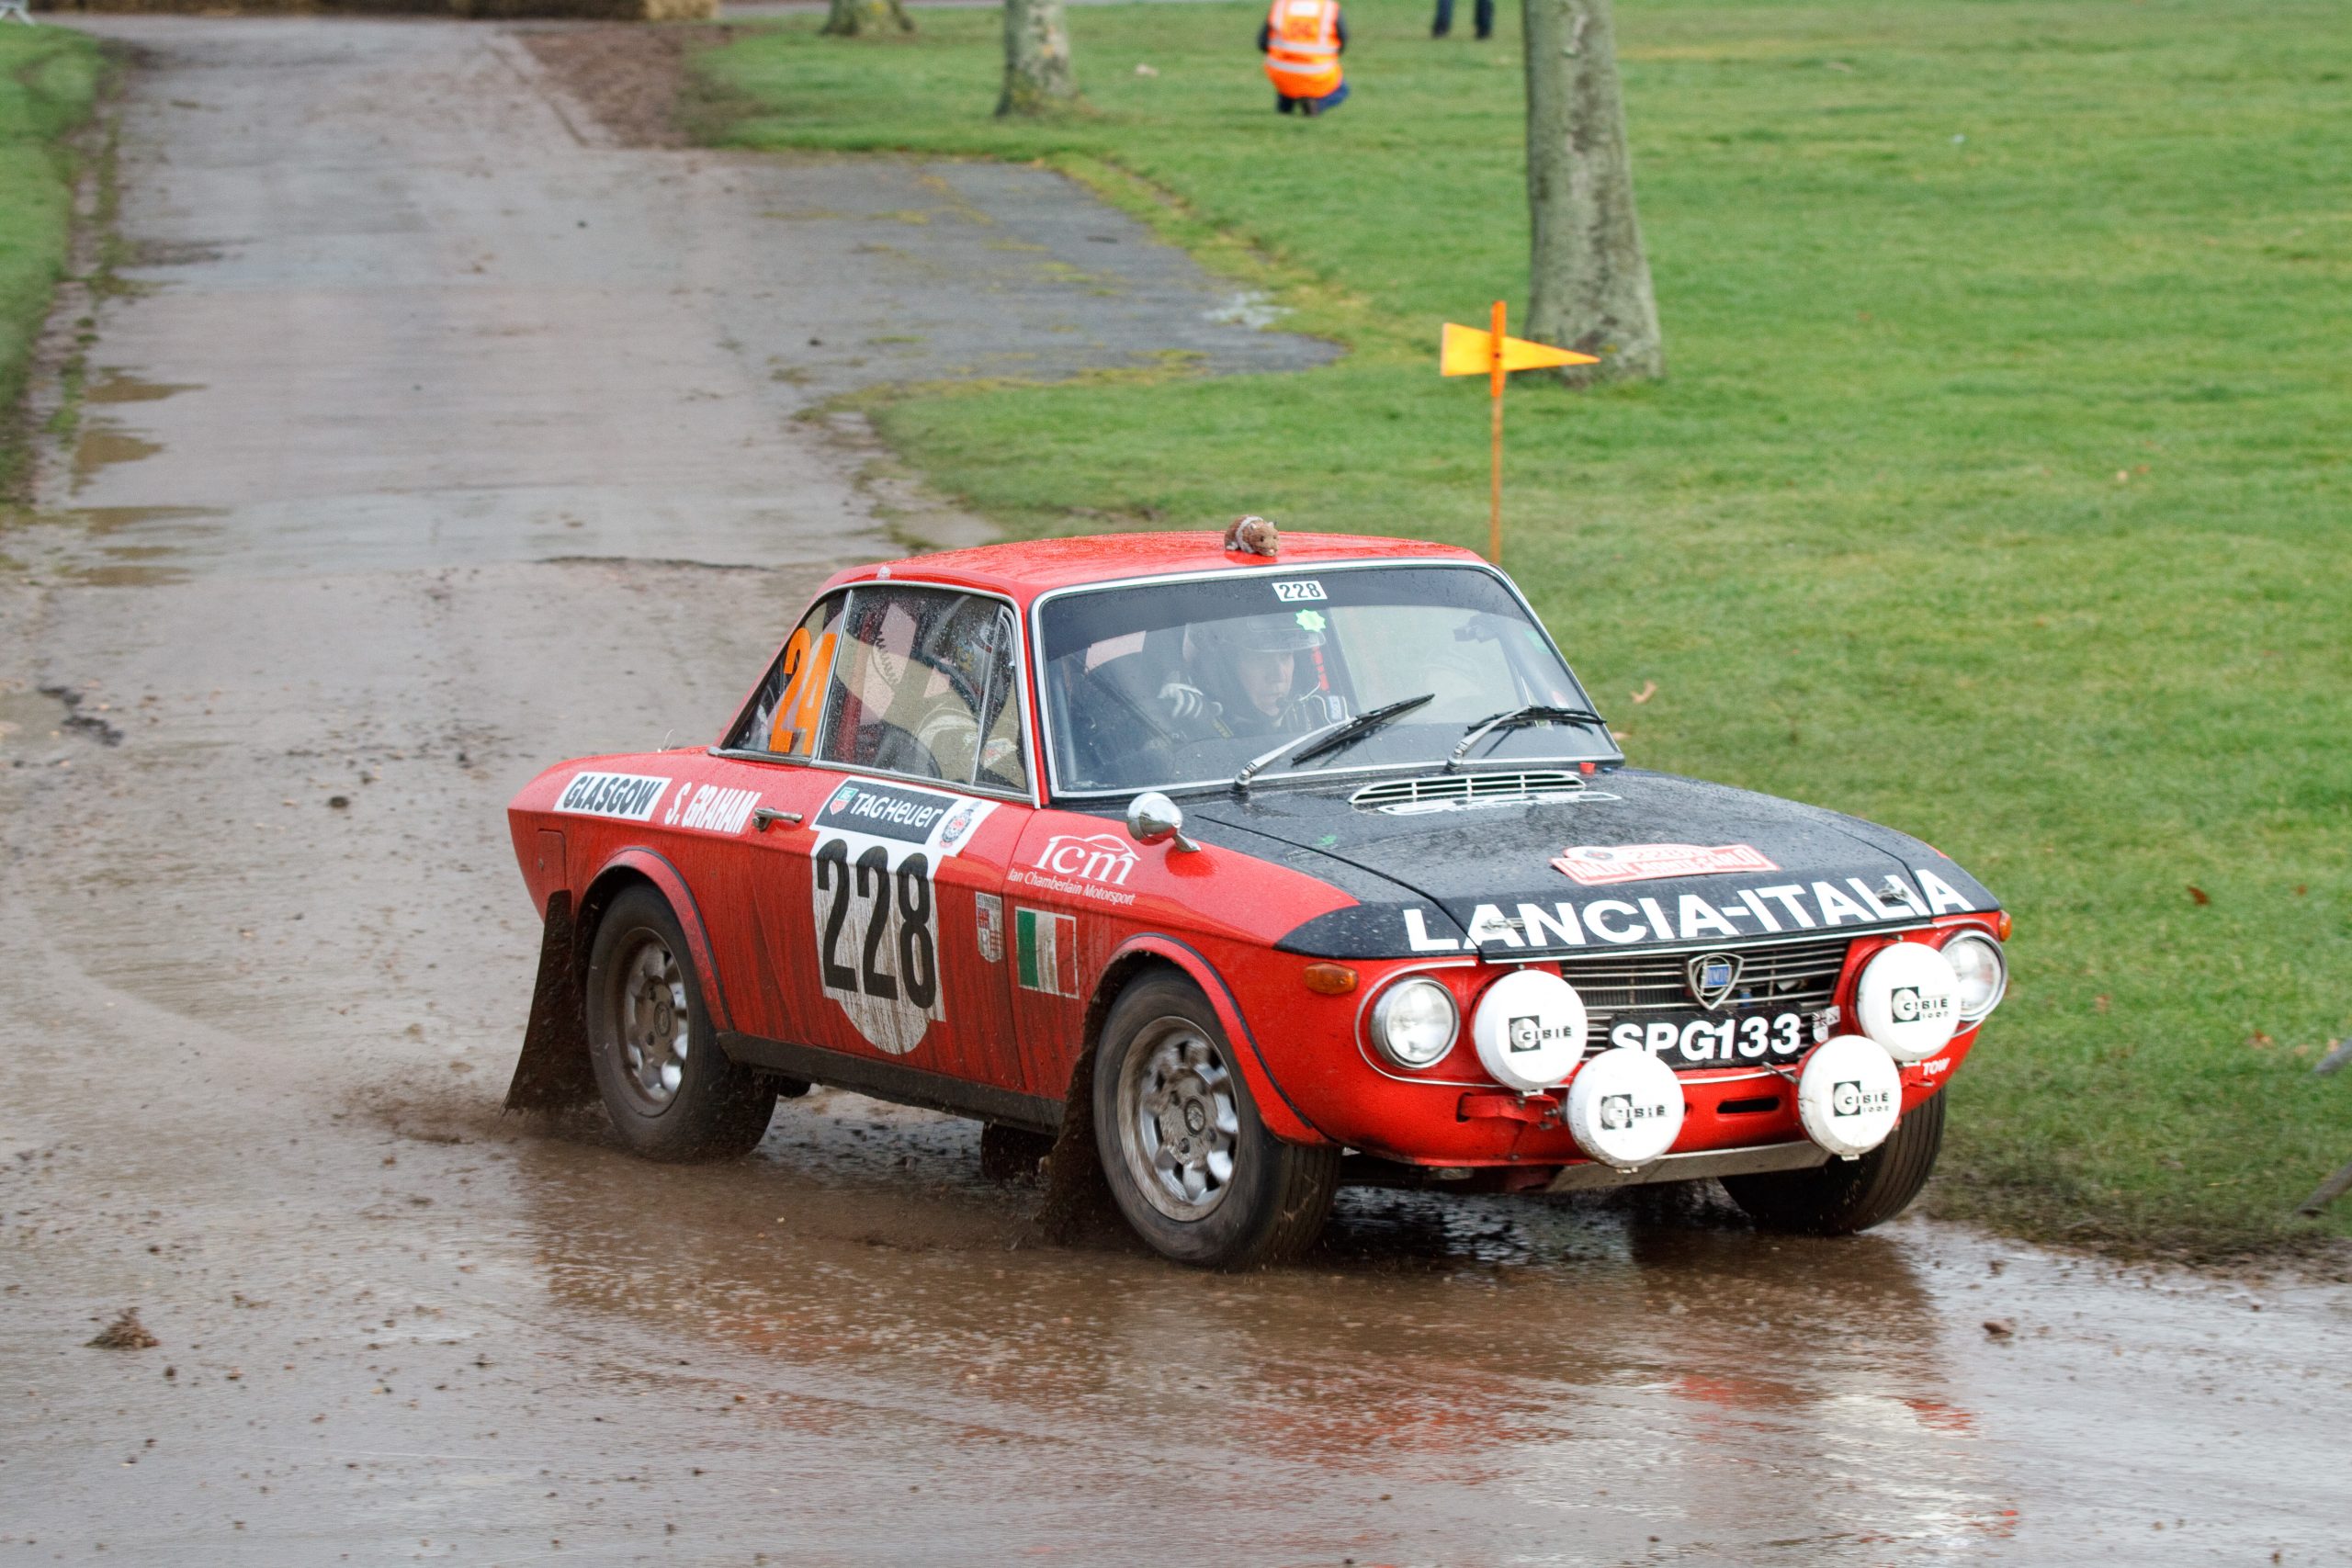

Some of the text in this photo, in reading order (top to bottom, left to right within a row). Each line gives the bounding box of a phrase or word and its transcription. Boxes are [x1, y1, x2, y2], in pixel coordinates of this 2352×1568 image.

[1278, 582, 1321, 599] 228
[563, 775, 662, 816] GLASGOW
[664, 782, 763, 833] S. GRAHAM
[1024, 871, 1083, 896] Chamberlain
[1083, 883, 1136, 907] Motorsport
[816, 838, 936, 1010] 228
[1402, 868, 1974, 953] LANCIA-ITALIA
[1922, 1056, 1951, 1077] TOW
